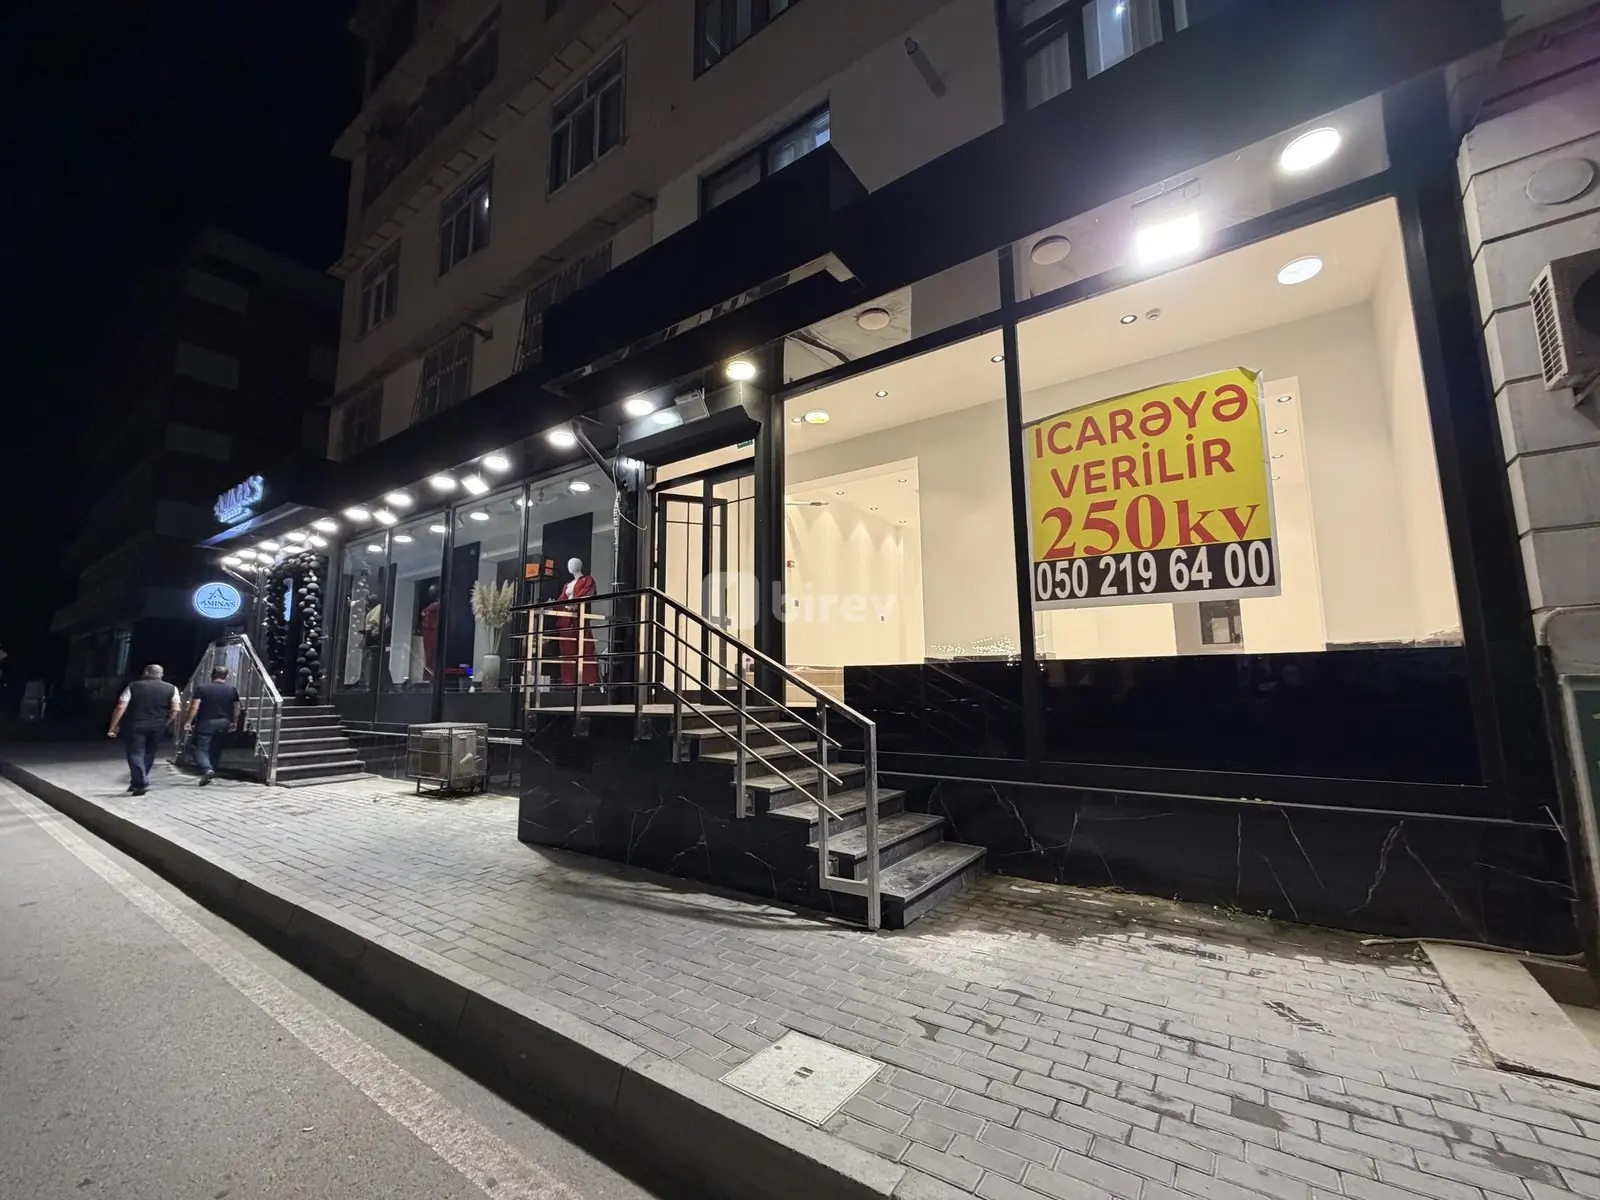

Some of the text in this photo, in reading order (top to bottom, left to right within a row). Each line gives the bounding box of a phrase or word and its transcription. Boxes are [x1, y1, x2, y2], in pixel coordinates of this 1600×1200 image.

[1035, 384, 1248, 458] ICARƏYƏ
[1050, 433, 1235, 499] VERİLİR
[1036, 540, 1270, 600] 050 219 64 00
